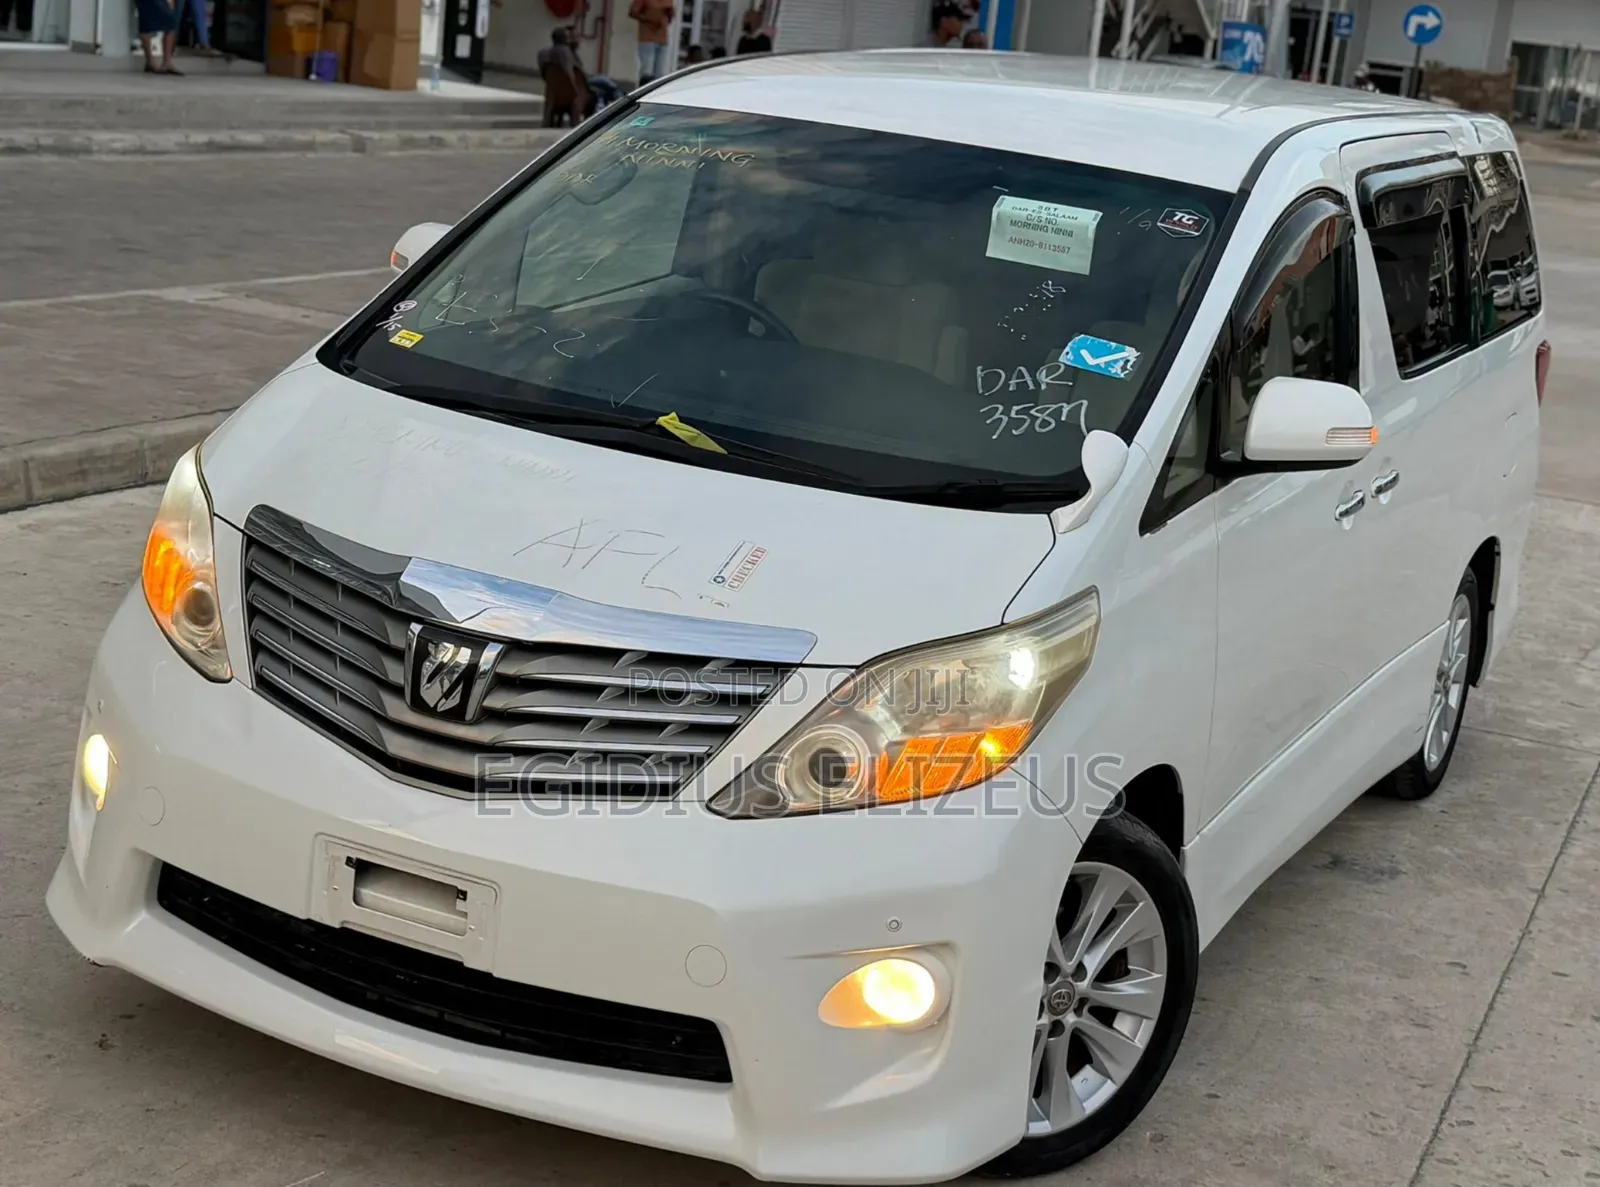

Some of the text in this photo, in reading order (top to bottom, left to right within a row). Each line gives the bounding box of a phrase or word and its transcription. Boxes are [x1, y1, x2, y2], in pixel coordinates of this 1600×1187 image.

[615, 135, 756, 168] MORNING
[1010, 219, 1049, 234] MORNING
[1172, 211, 1199, 225] TG
[976, 362, 1074, 396] DAR
